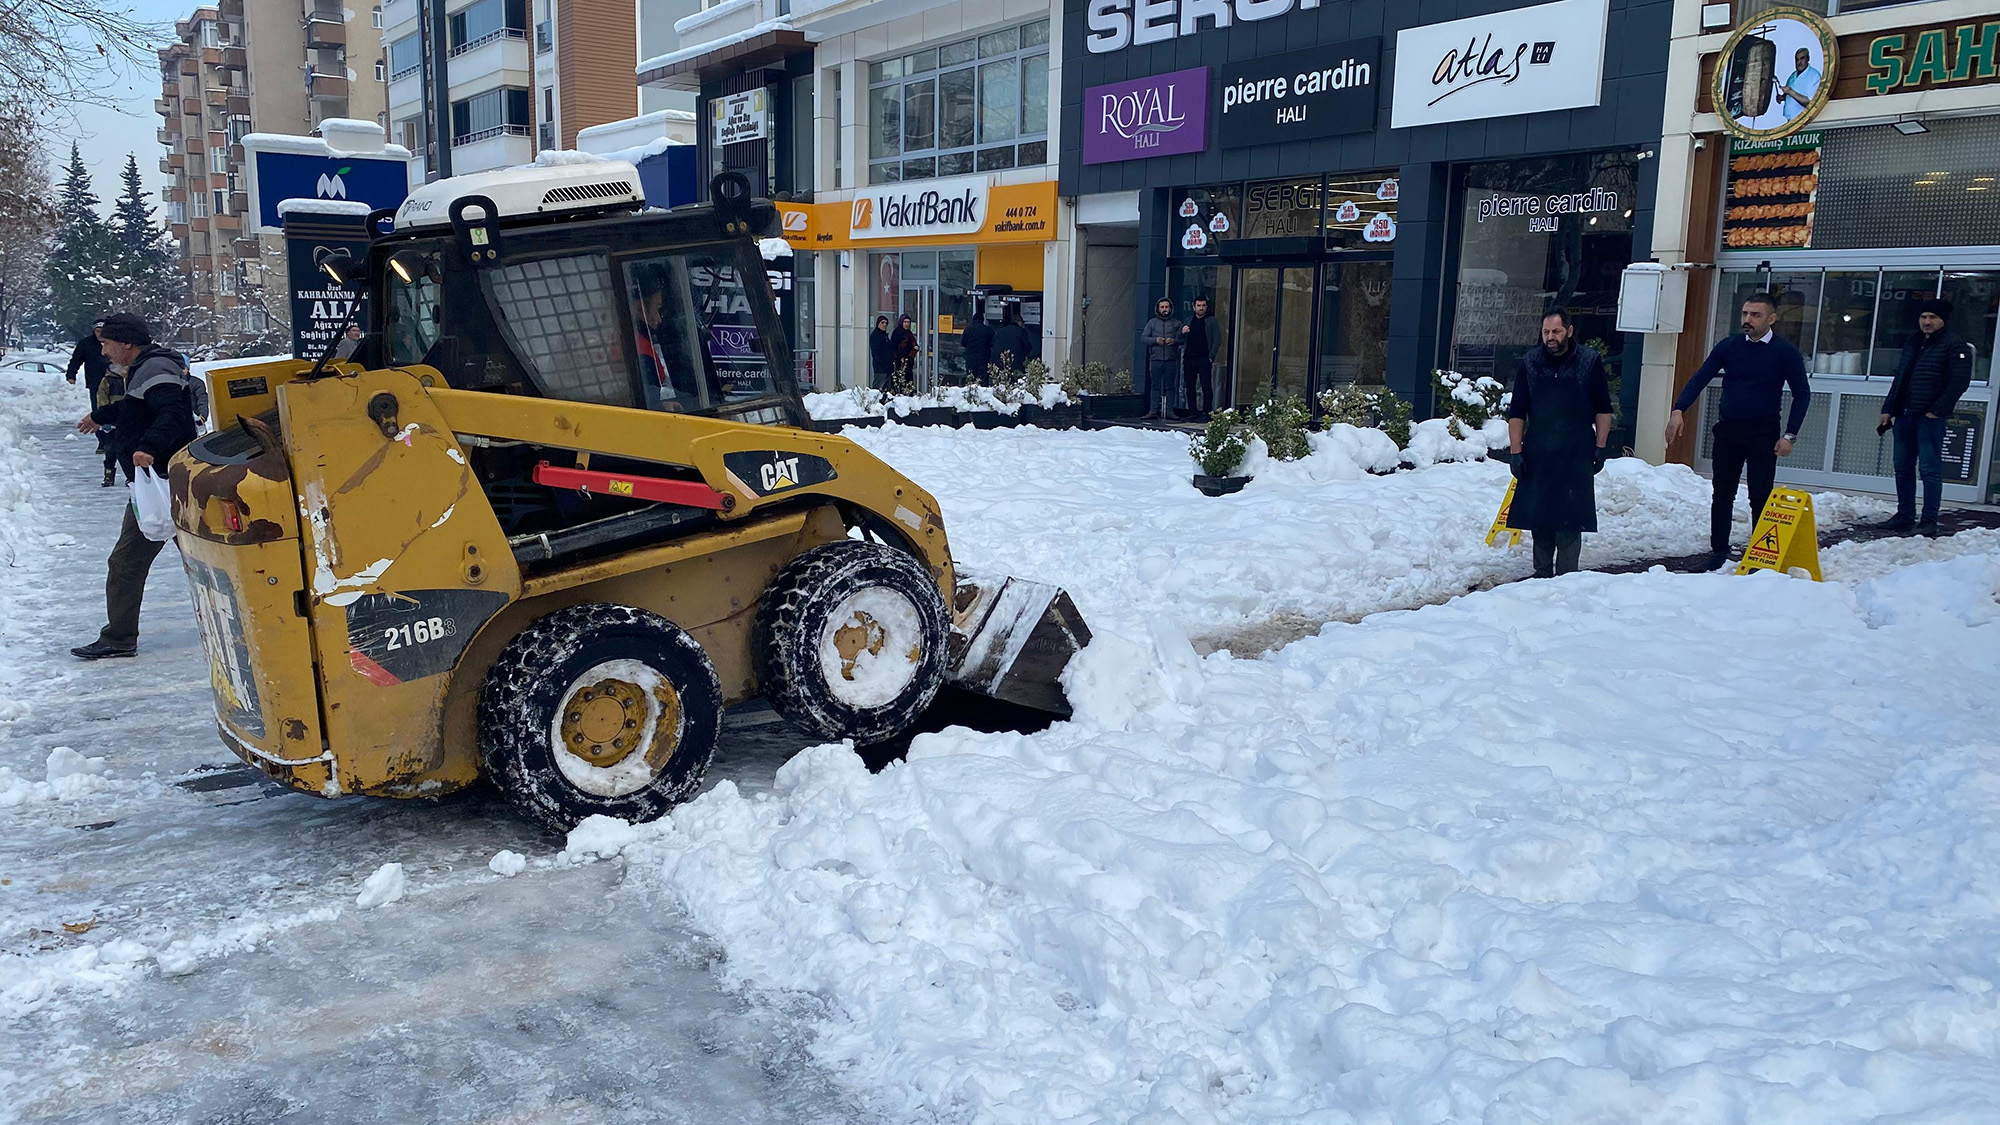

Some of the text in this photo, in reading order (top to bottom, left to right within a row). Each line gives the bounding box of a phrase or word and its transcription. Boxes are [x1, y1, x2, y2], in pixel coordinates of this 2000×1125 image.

[1432, 32, 1528, 85] atlas
[1866, 21, 2000, 95] ŞAH
[1223, 58, 1371, 114] pierre cardin
[1101, 84, 1186, 138] ROYAL
[1276, 104, 1307, 125] HALI
[1134, 132, 1160, 149] HALI
[1786, 133, 1820, 146] TAVUK
[879, 188, 979, 228] VakıfBank
[1005, 206, 1037, 218] 444 0 724
[1478, 187, 1618, 222] pierre cardin
[1529, 217, 1559, 232] HALI
[760, 457, 799, 491] CAT
[1749, 550, 1779, 560] CAUTION
[384, 617, 457, 651] 216B3
